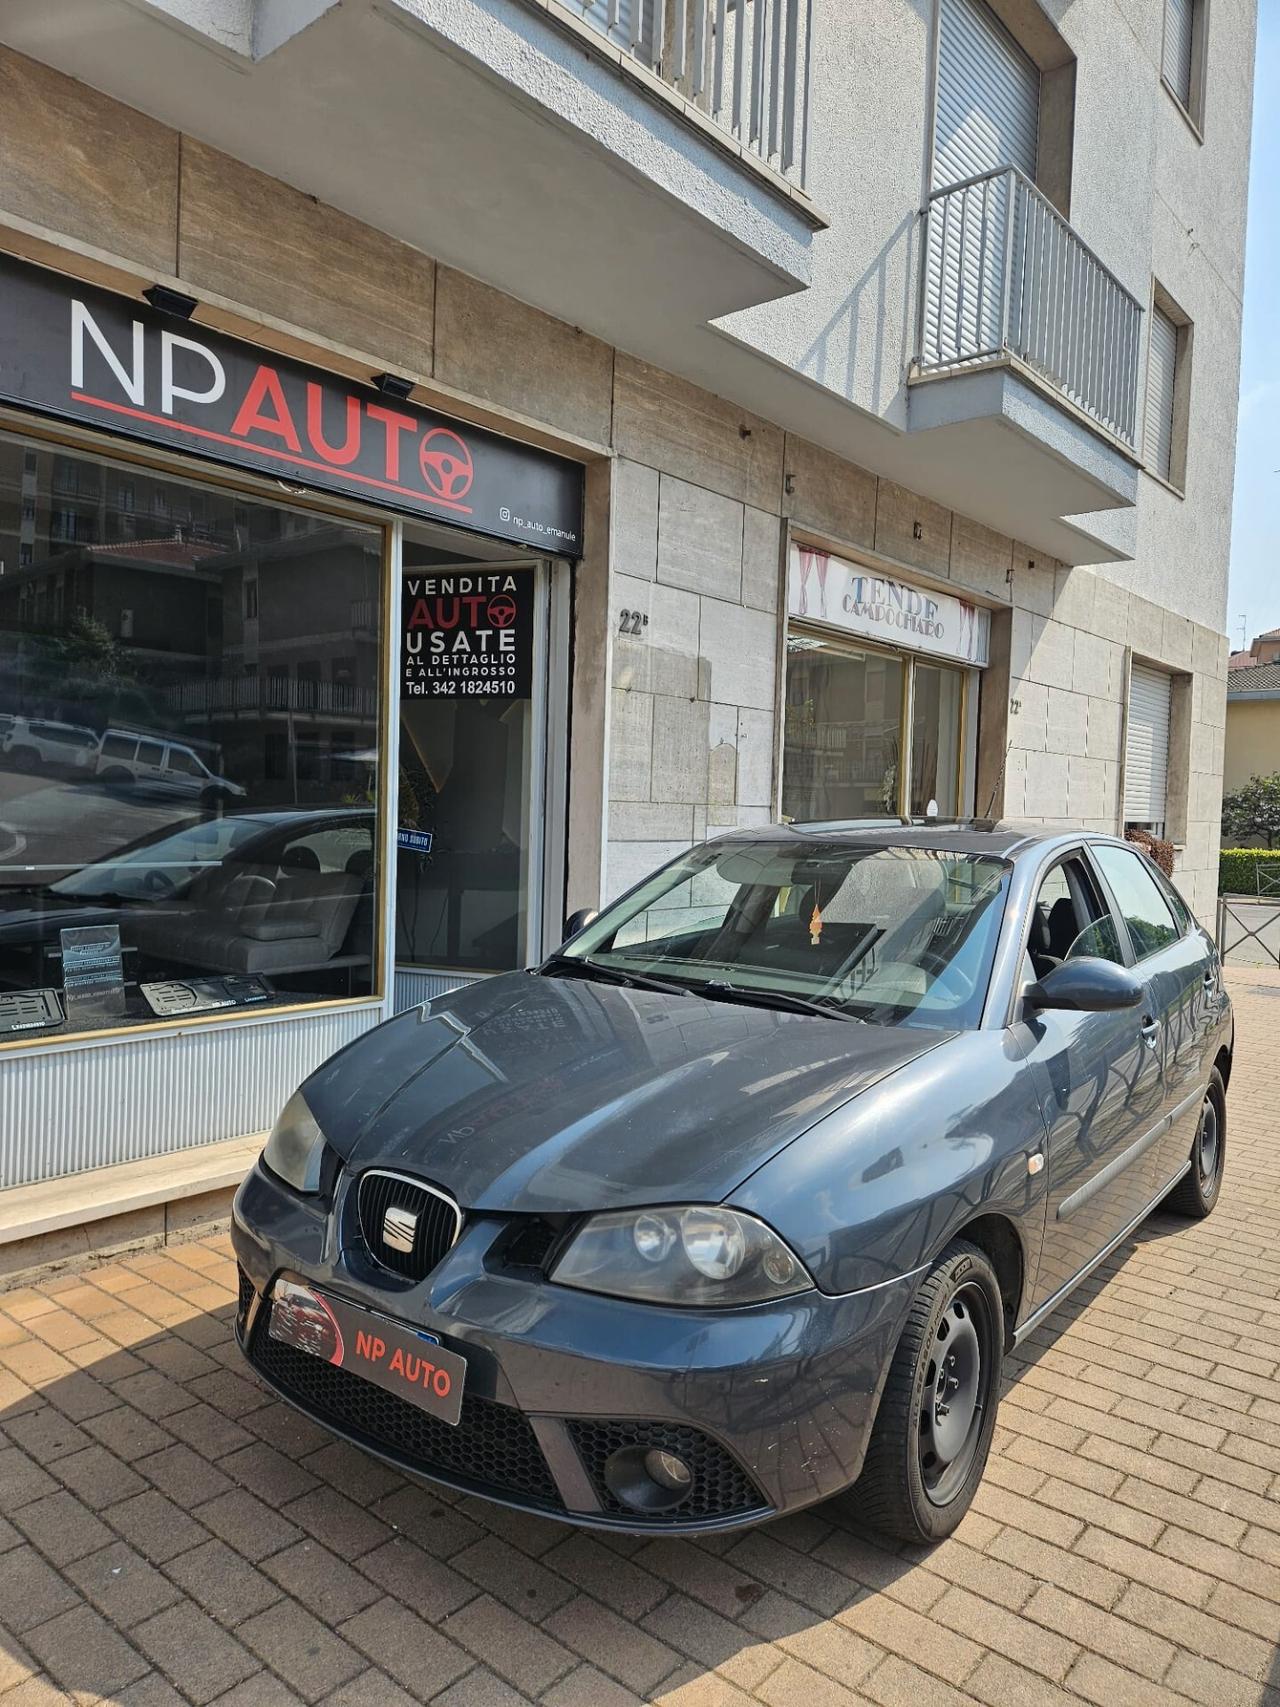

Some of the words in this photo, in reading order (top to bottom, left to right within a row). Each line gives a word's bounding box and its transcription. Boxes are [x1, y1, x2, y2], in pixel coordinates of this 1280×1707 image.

[513, 516, 576, 541] np_auto_emanule
[407, 576, 517, 595] VENDITA
[406, 629, 515, 653] USATE
[406, 656, 424, 666] AL
[431, 653, 516, 665] DETTAGLIO
[405, 668, 412, 677] E
[418, 667, 516, 677] ALL'INGROSSO
[406, 681, 428, 694] Tel.
[432, 681, 456, 694] 342
[460, 680, 515, 694] 1824510
[355, 1330, 386, 1362] NP
[388, 1348, 451, 1397] AUTO
